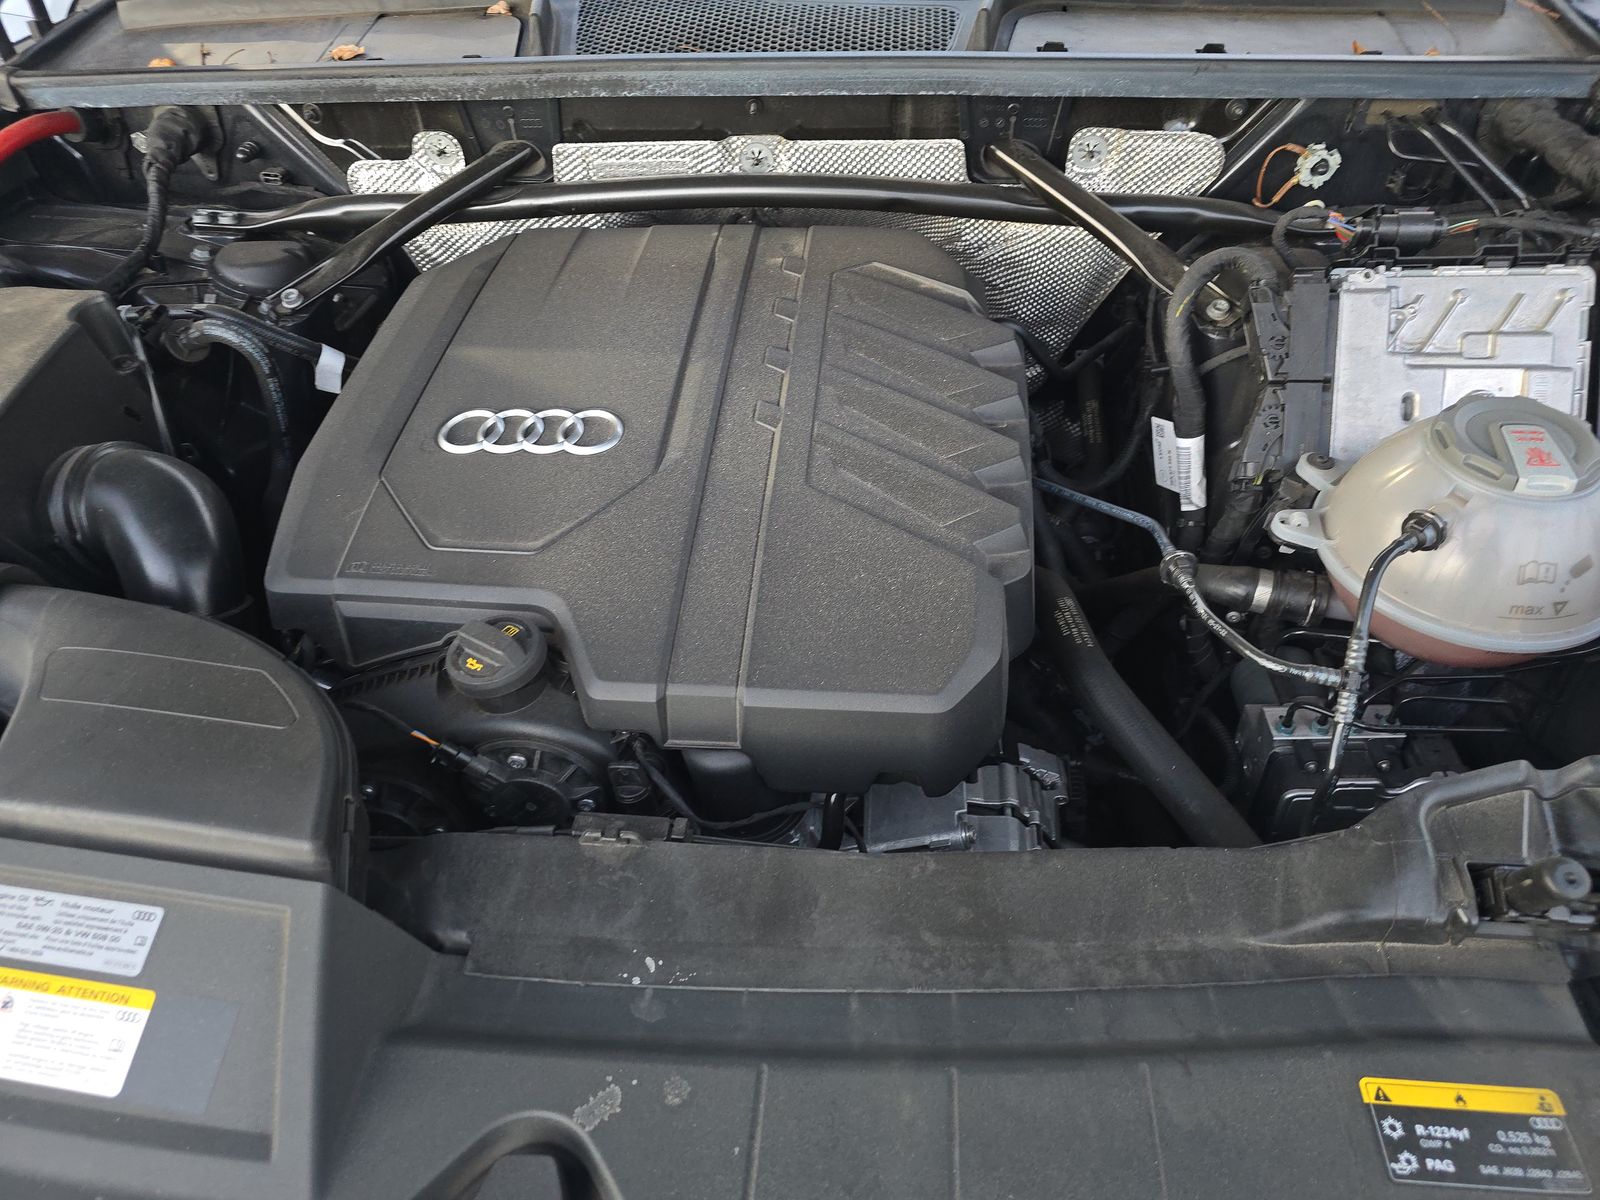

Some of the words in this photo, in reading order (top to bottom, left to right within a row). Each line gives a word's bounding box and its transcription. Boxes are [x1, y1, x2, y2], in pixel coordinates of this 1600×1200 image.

[1508, 604, 1544, 616] max
[56, 984, 131, 1006] ATTENTION
[1425, 1157, 1457, 1173] PAG
